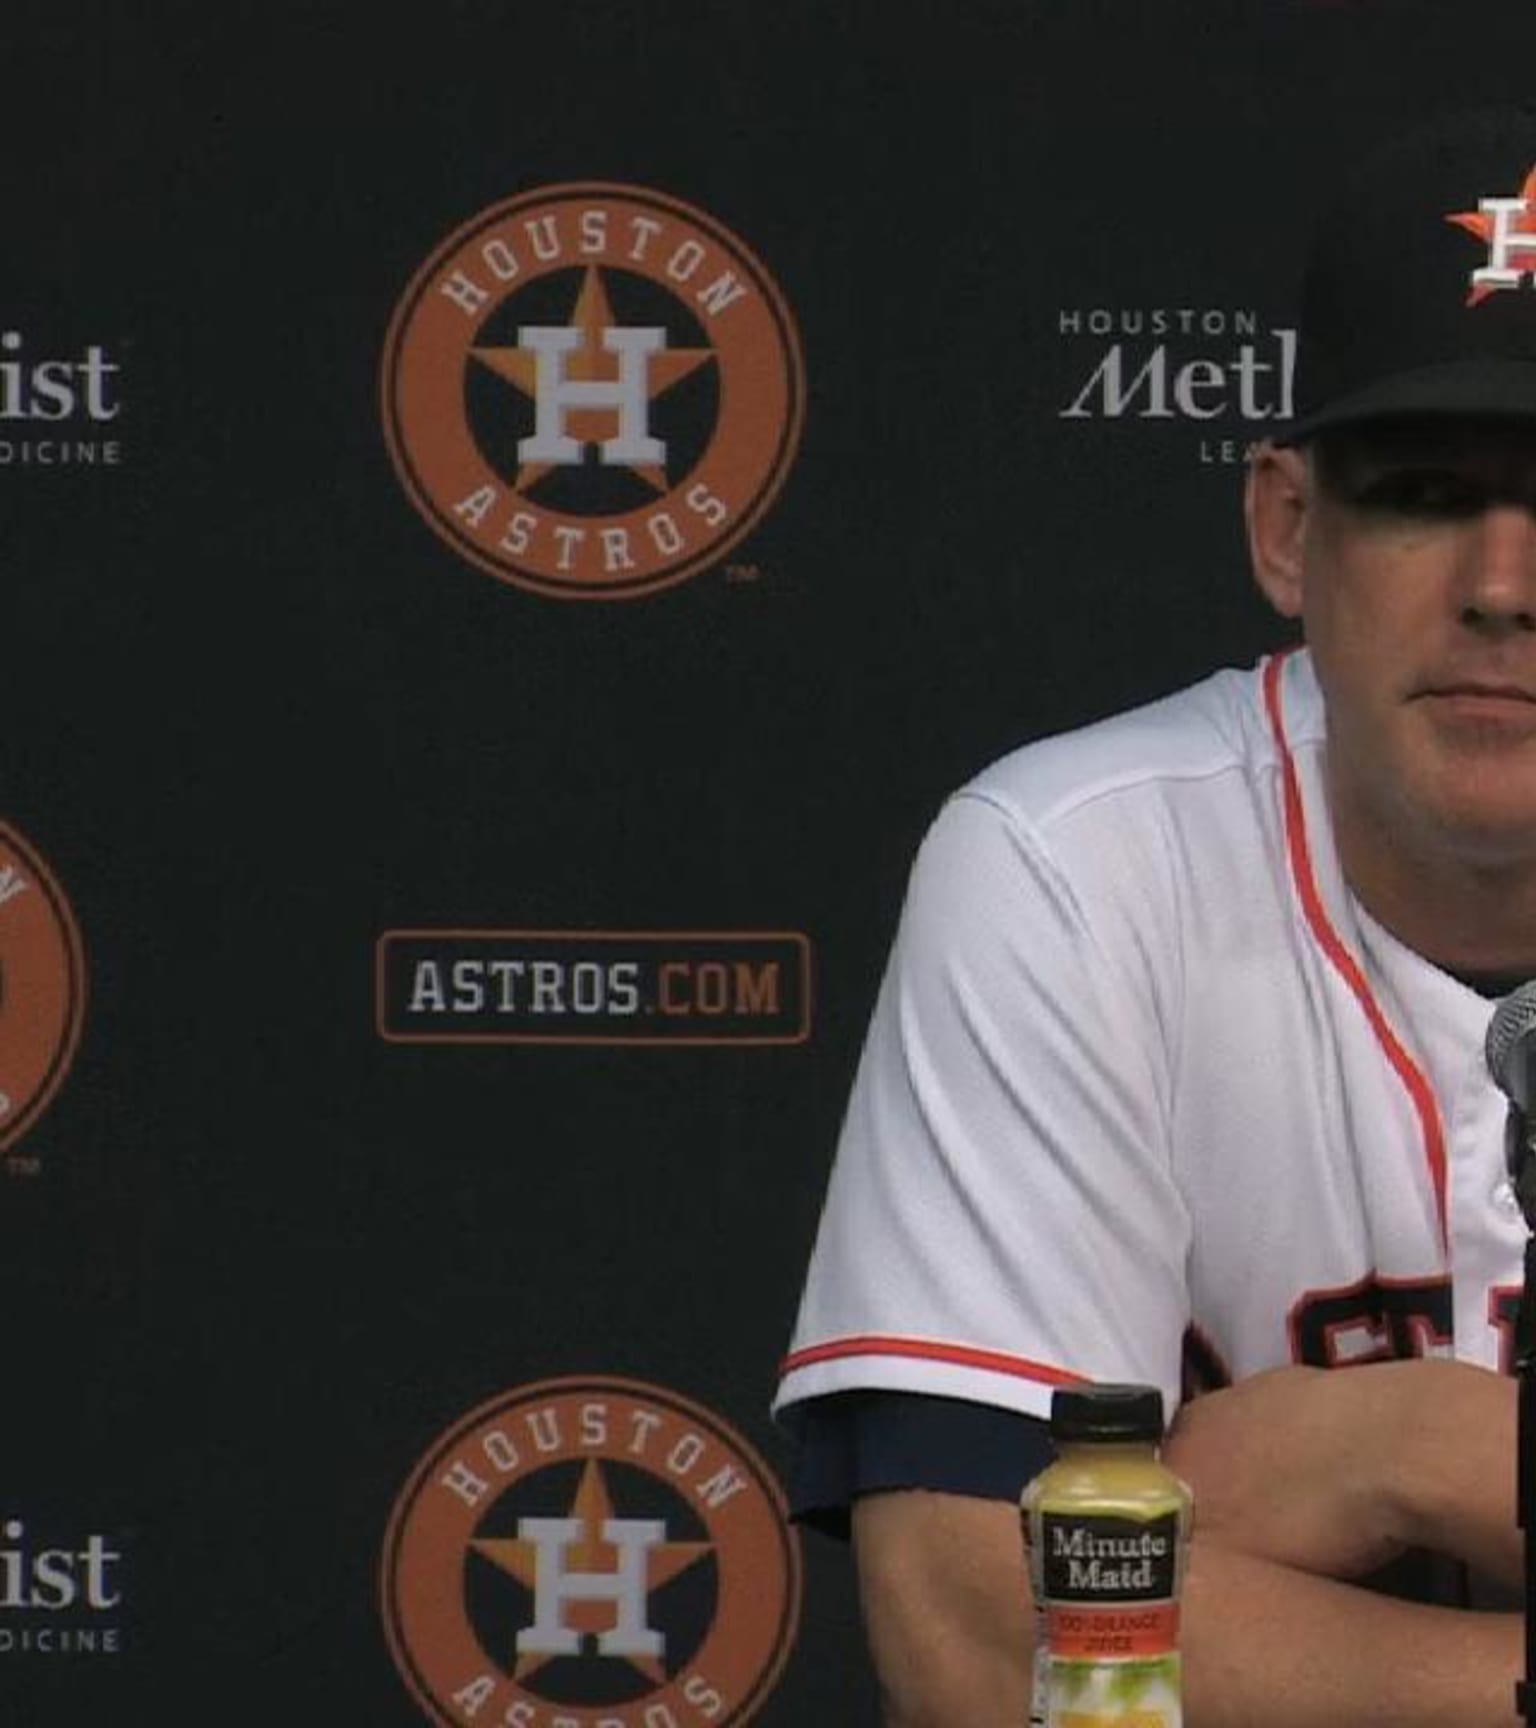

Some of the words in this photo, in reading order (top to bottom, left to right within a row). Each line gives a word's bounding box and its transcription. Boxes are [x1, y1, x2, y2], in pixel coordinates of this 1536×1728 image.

[440, 209, 748, 317] HOUSTON
[1058, 308, 1257, 336] HOUSTON
[0, 331, 120, 421] ist
[517, 326, 667, 465] H
[0, 440, 120, 464] DICINE
[452, 482, 729, 572] ASTROS
[408, 960, 780, 1015] ASTROS.COM
[440, 1402, 748, 1509] HOUSTON
[0, 1519, 121, 1609] ist
[516, 1517, 667, 1656] H
[1051, 1527, 1167, 1559] Minute
[1069, 1559, 1153, 1590] Maid
[0, 1628, 119, 1652] DICINE
